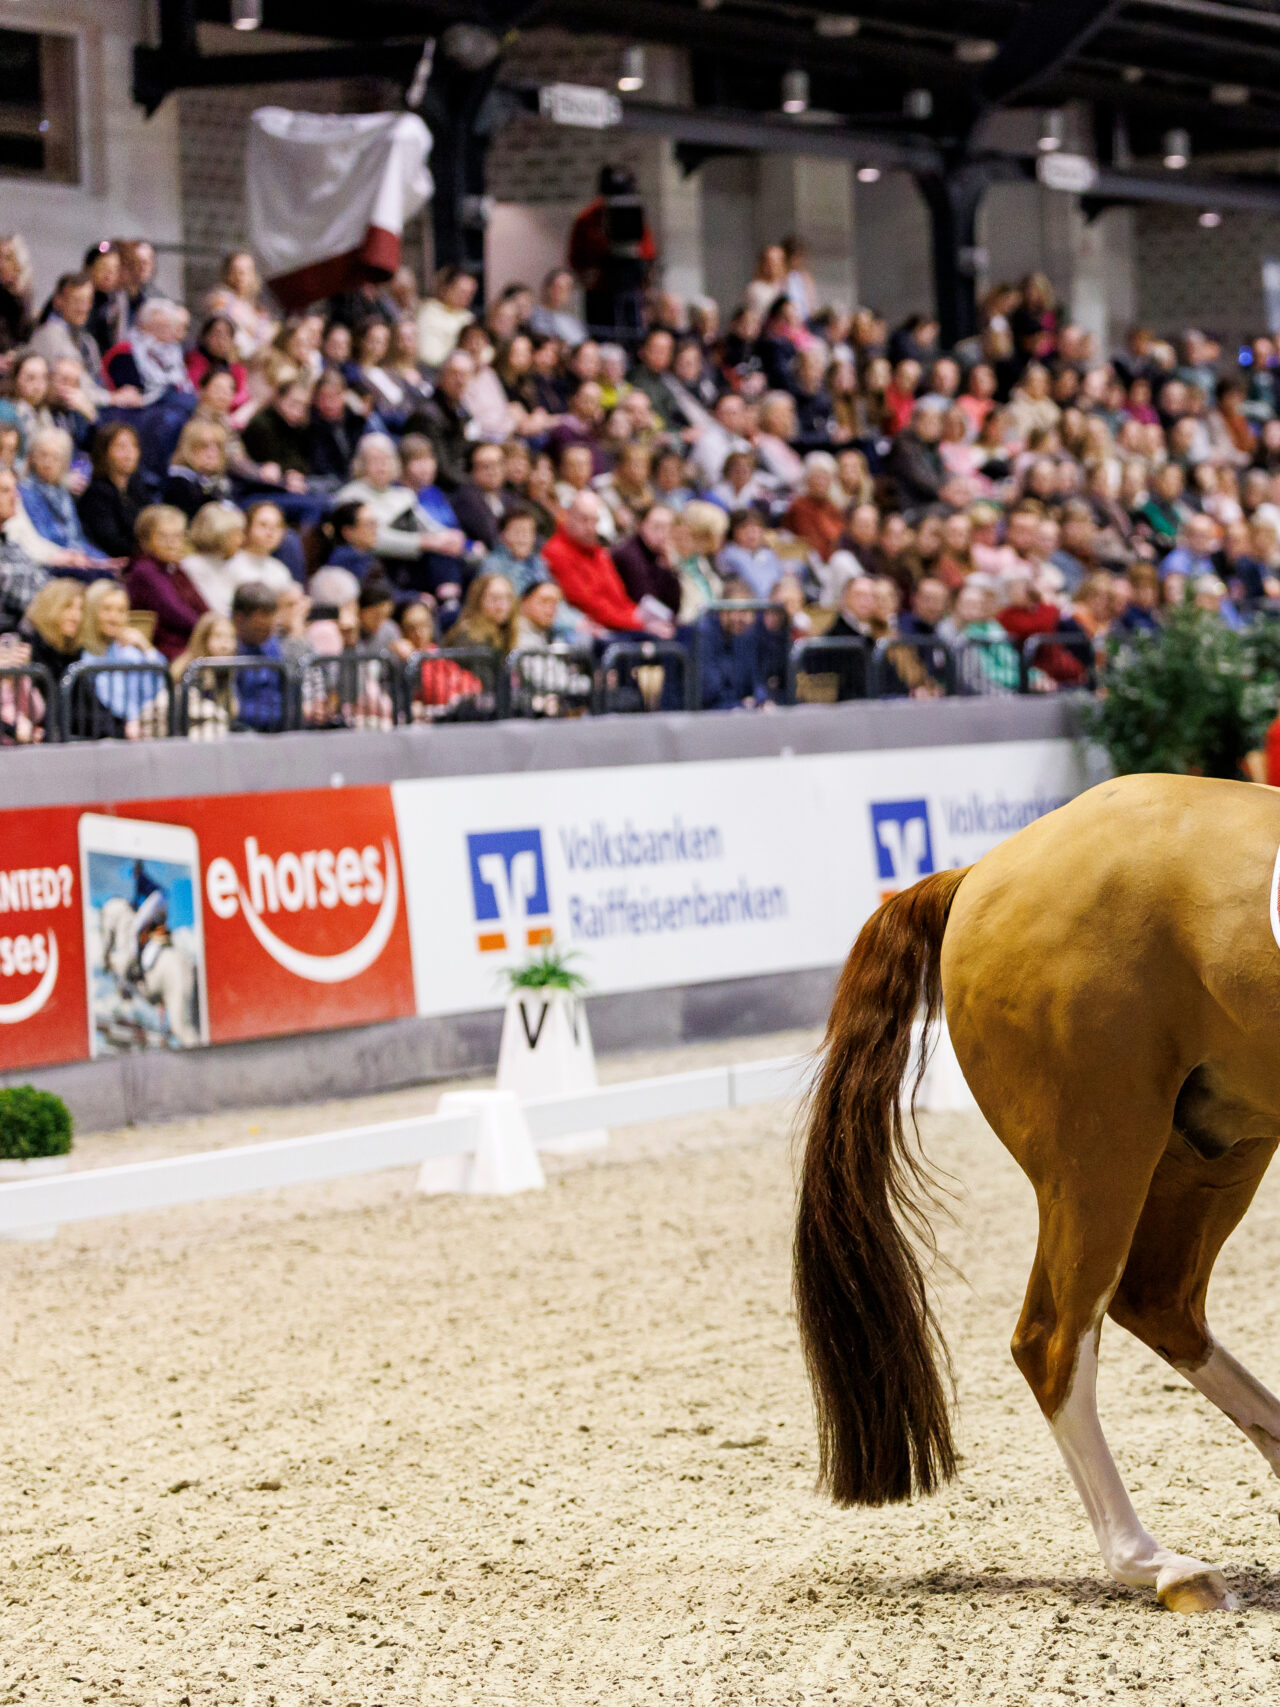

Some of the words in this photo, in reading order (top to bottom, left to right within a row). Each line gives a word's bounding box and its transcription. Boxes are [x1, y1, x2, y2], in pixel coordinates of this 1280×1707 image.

[558, 813, 725, 872] Volksbanken
[568, 874, 788, 940] Raiffeisenbanken
[519, 1001, 549, 1050] V
